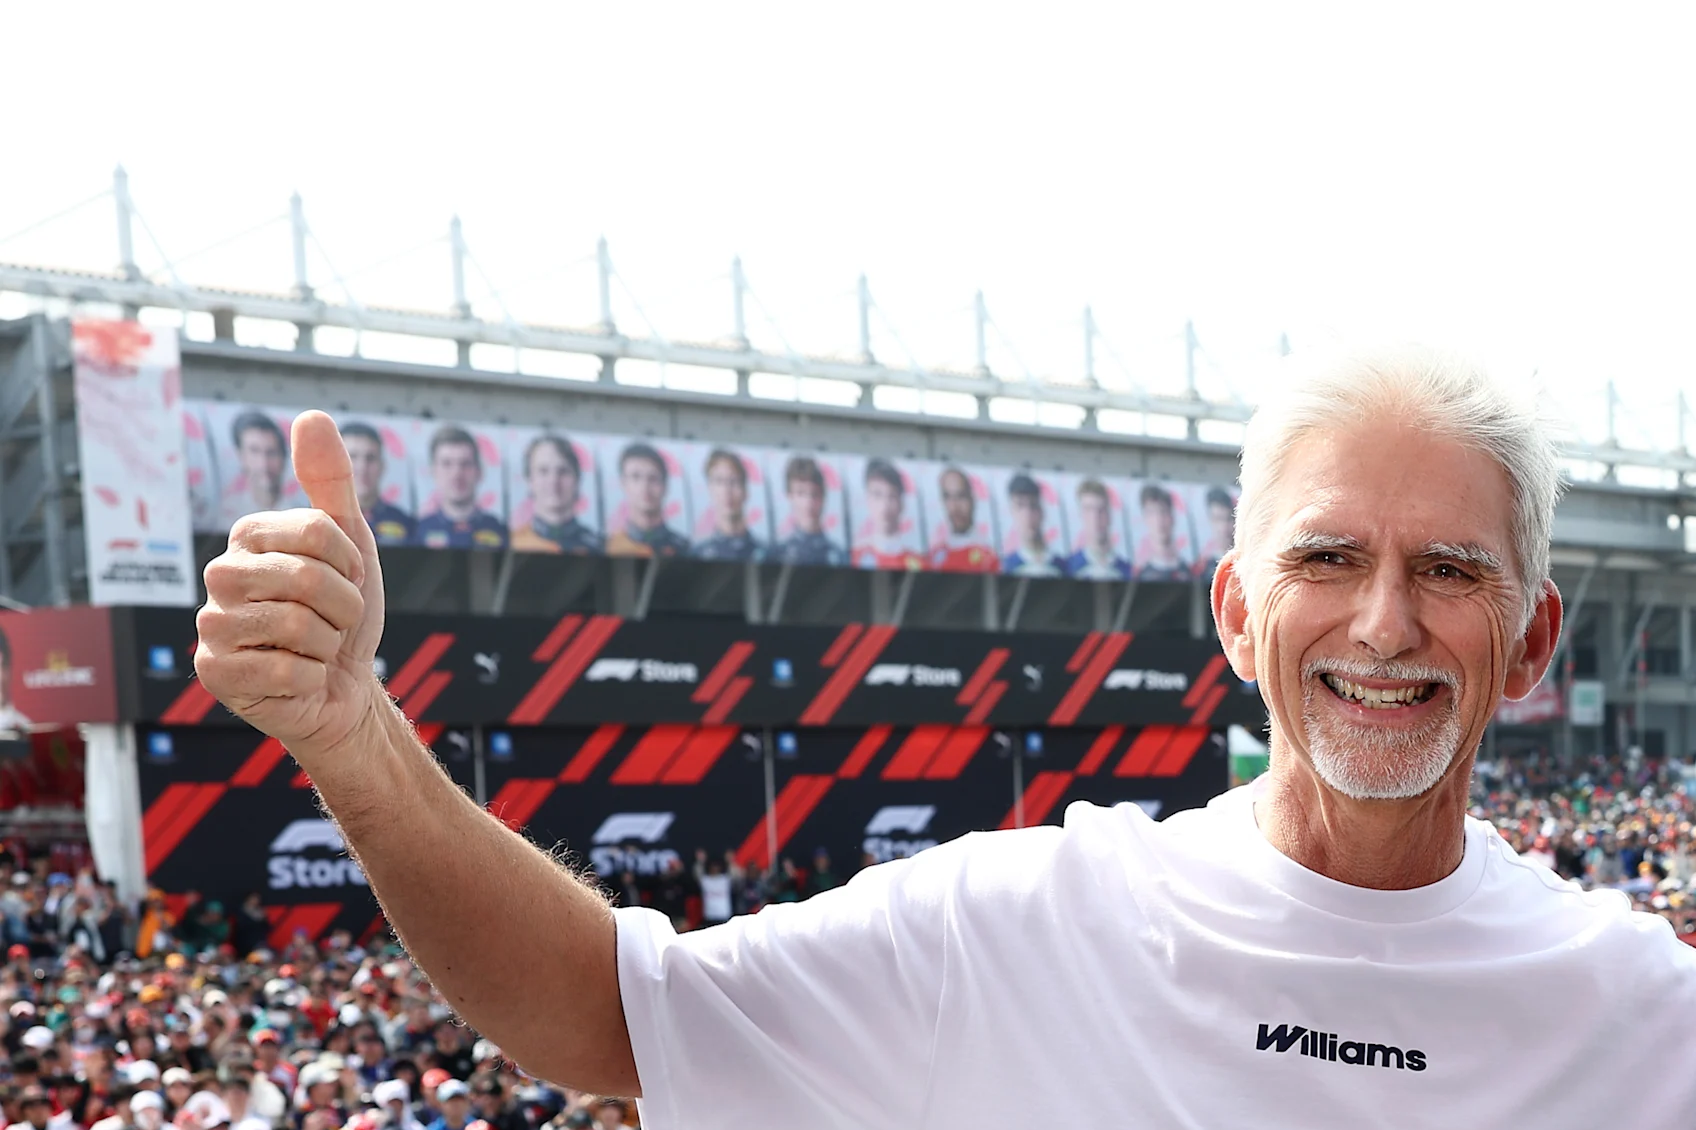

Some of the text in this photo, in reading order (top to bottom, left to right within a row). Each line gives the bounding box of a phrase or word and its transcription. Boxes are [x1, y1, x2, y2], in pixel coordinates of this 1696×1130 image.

[641, 659, 698, 683] Store
[911, 663, 961, 687] Store
[1256, 1023, 1427, 1071] Williams
